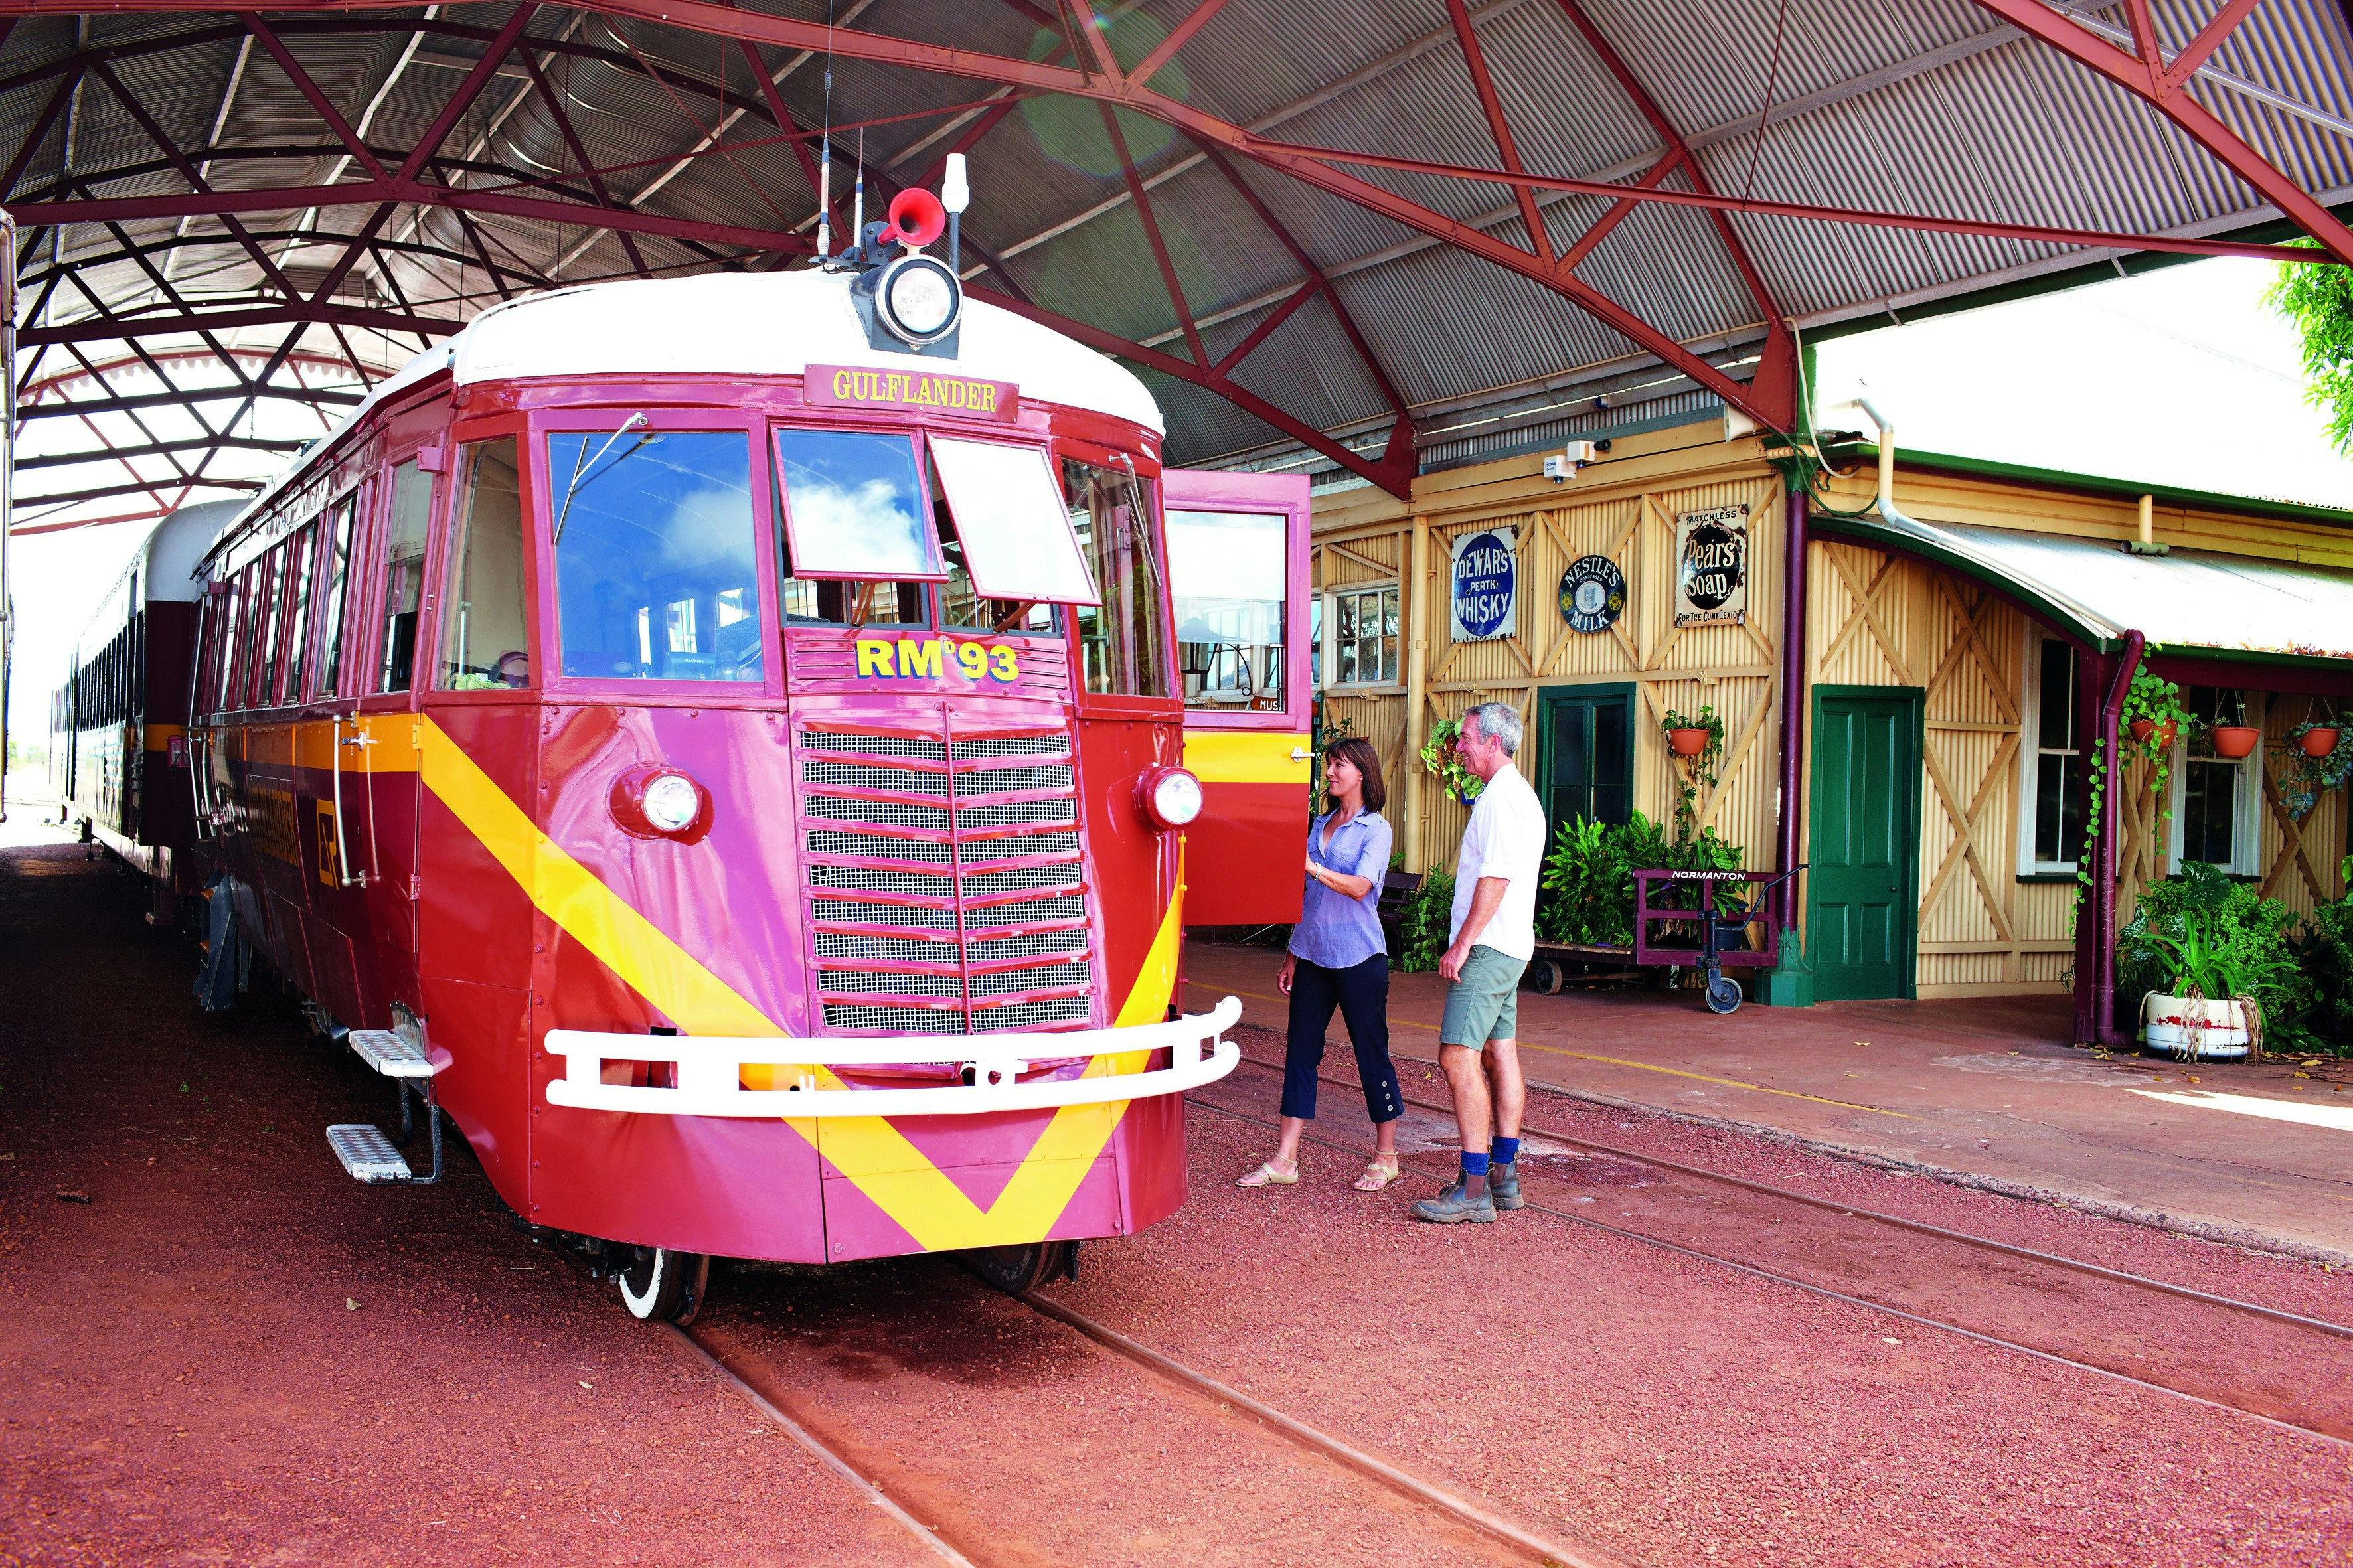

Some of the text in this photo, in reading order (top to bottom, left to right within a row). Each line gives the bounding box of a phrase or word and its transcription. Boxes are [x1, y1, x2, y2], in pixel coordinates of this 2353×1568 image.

[833, 370, 997, 412] GULFLANDER
[1686, 510, 1736, 526] MATCHLESS
[1457, 548, 1508, 579] DEWAR'S
[1470, 580, 1496, 592] PERTH
[1457, 592, 1509, 623] WHISKY
[1570, 610, 1609, 631] MILK
[1679, 613, 1690, 622] FOR
[1672, 870, 1746, 880] NORMANTON
